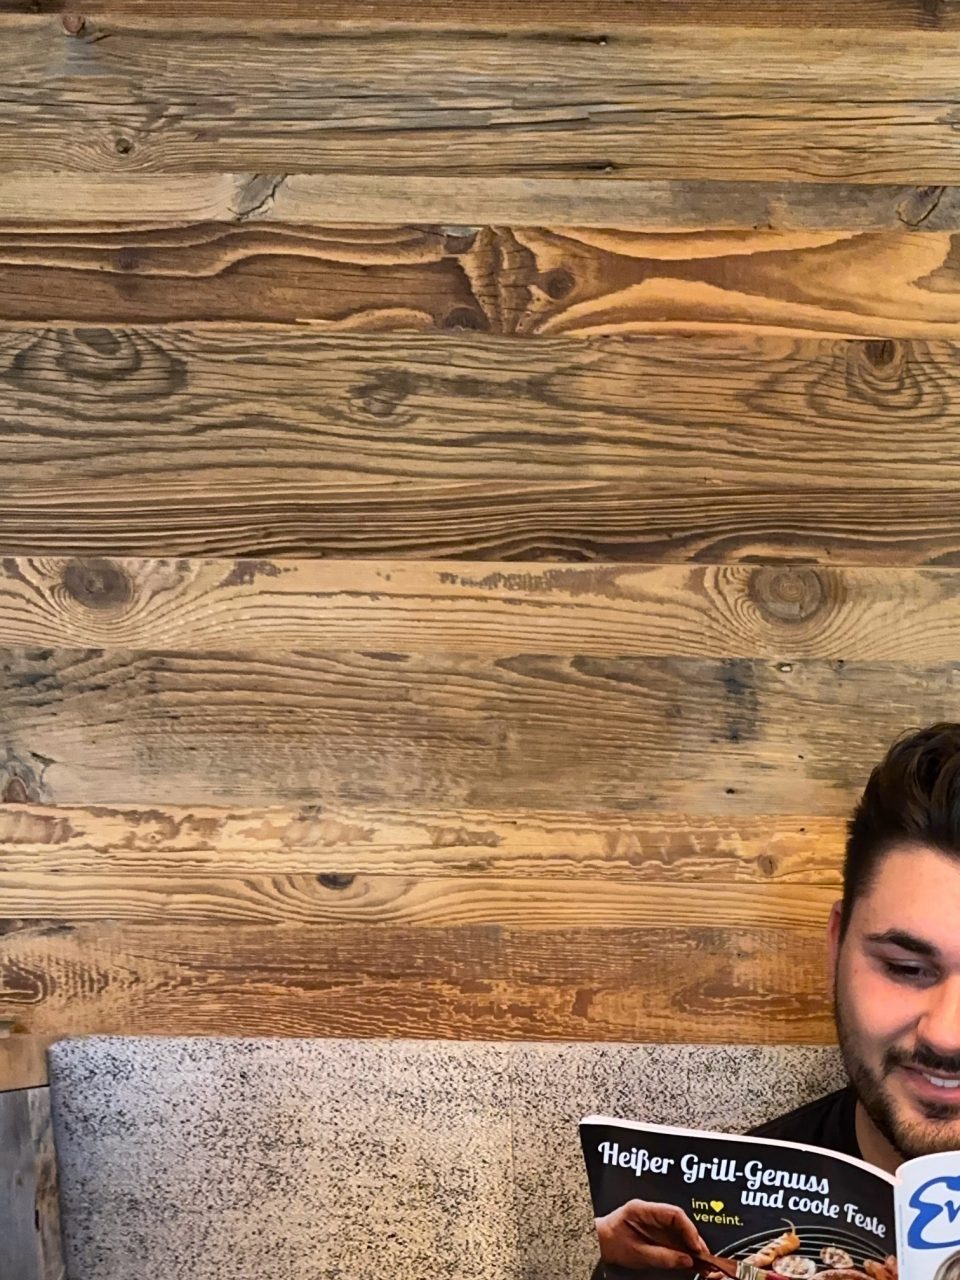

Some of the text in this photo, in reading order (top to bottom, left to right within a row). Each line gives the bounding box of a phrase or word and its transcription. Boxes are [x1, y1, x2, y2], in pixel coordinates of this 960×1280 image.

[598, 1141, 830, 1195] Heißer Grill-Genuss
[691, 1198, 709, 1210] im
[693, 1211, 744, 1227] vereint.
[740, 1189, 887, 1239] und coole Feste
